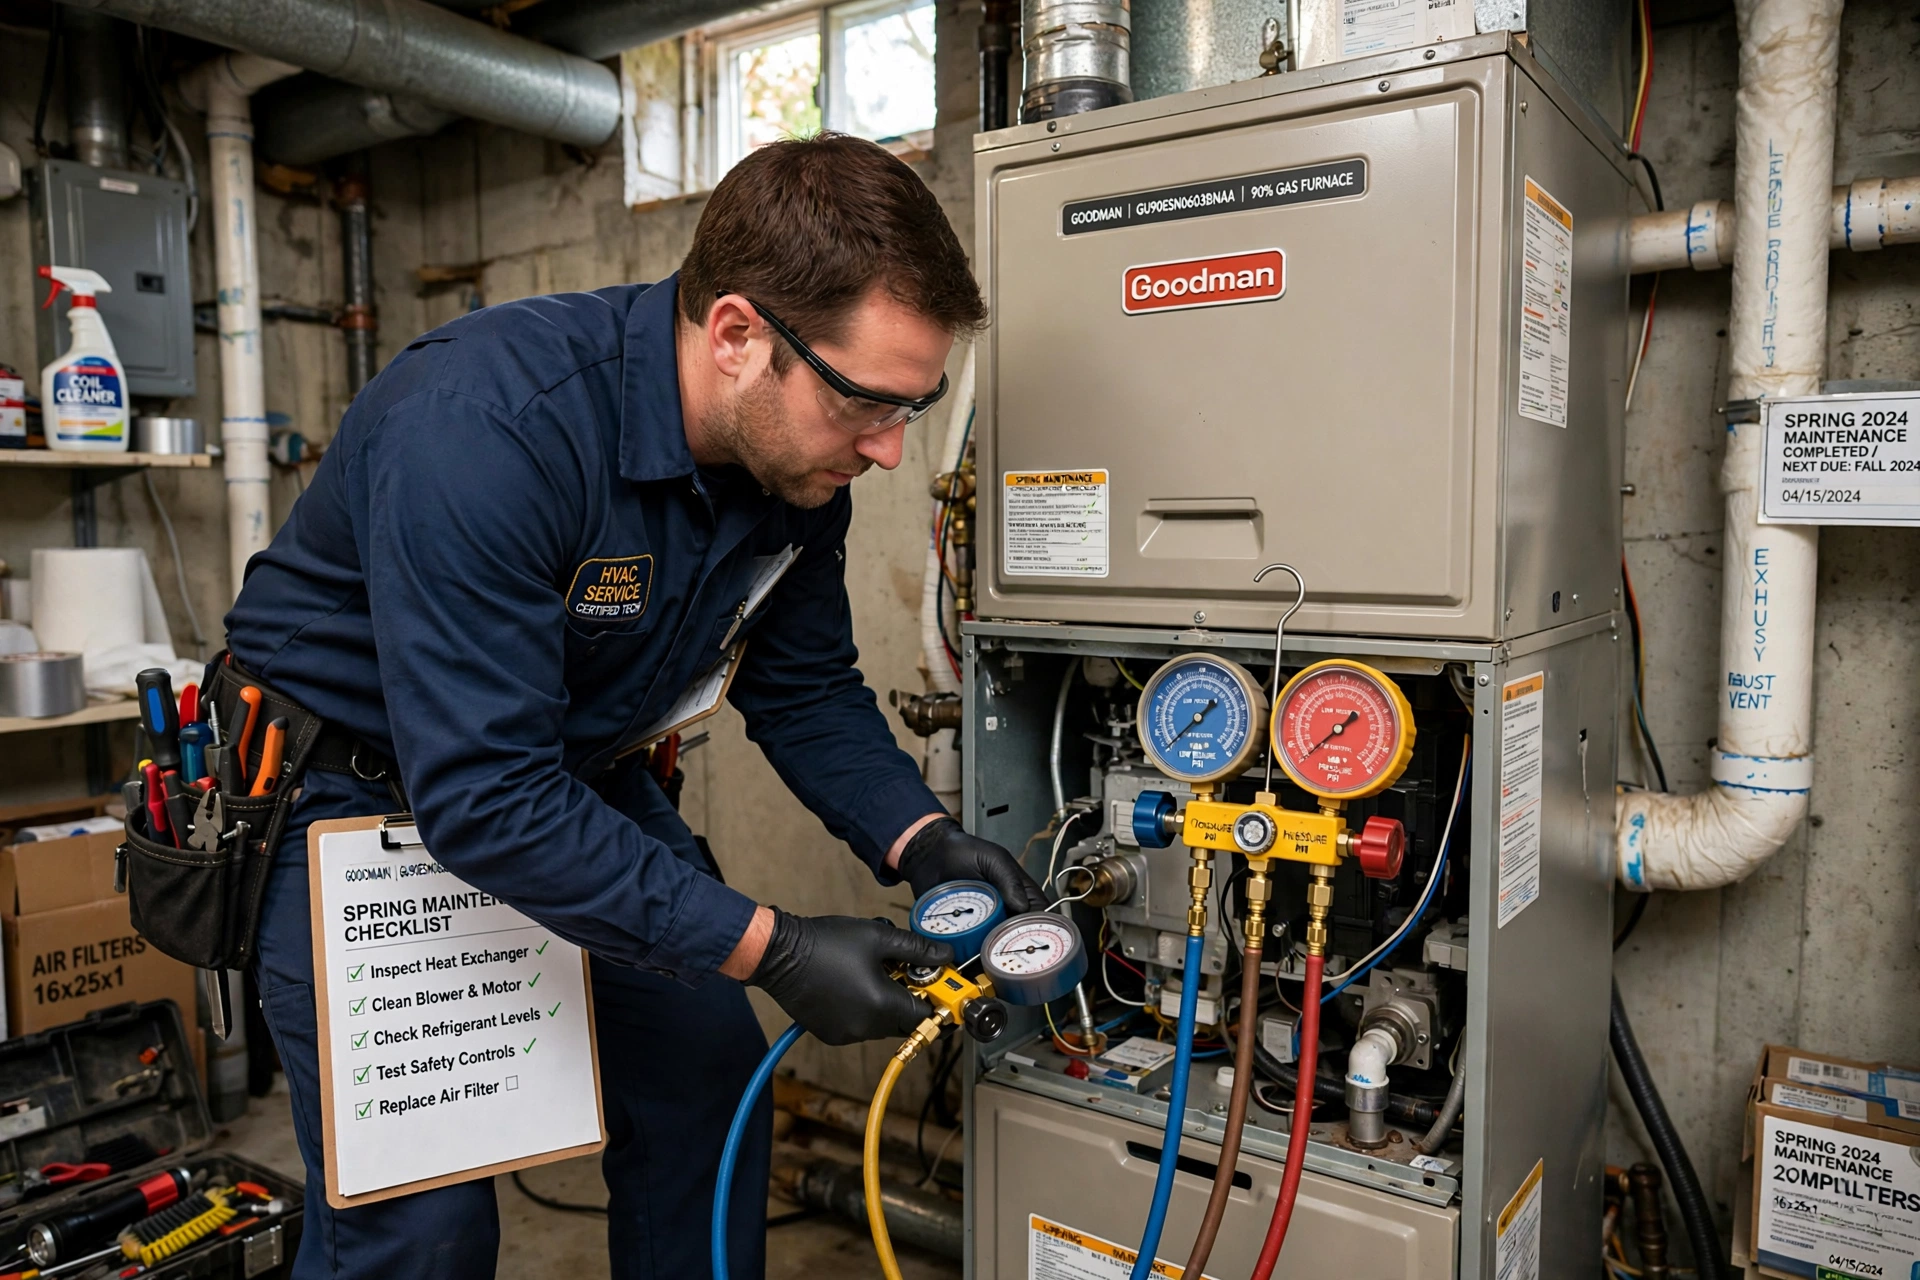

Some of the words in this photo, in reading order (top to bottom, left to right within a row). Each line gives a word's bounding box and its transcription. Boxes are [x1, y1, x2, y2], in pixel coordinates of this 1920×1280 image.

[1071, 206, 1122, 225] GOODMAN
[1251, 184, 1274, 199] 90%
[1276, 180, 1298, 195] GAS
[1301, 172, 1354, 192] FURNACE
[1131, 267, 1275, 301] Goodman
[56, 388, 116, 404] CLEANER
[69, 375, 103, 389] COIL
[1784, 412, 1855, 428] SPRING
[1861, 411, 1908, 427] 2024
[1784, 429, 1907, 444] MAINTENANCE
[1782, 461, 1818, 472] NEXT
[1820, 461, 1852, 472] DUE:
[1855, 460, 1886, 472] FALL
[1889, 460, 1920, 472] 2024
[1783, 446, 1869, 458] COMPLETED
[1782, 489, 1861, 503] 04/15/2024
[600, 565, 638, 583] HVAC
[584, 583, 641, 602] SERVICE
[1729, 691, 1772, 709] VENT
[343, 899, 417, 922] SPRING
[344, 915, 452, 943] CHECKLIST
[33, 950, 66, 977] AIR
[73, 934, 146, 968] FILTERS
[371, 960, 421, 979] Inspect
[425, 955, 458, 971] Heat
[461, 946, 529, 966] Exchanger
[34, 964, 124, 1005] 16x25x1
[372, 996, 412, 1012] Clean
[416, 988, 464, 1006] Blower
[468, 984, 478, 998] &
[482, 979, 522, 996] Motor
[374, 1026, 419, 1046] Check
[422, 1015, 497, 1038] Refrigerant
[501, 1007, 541, 1025] Levels
[376, 1062, 407, 1080] Test
[411, 1055, 455, 1074] Safety
[458, 1045, 515, 1065] Controls
[379, 1094, 436, 1116] Replace
[440, 1087, 460, 1104] Air
[464, 1082, 500, 1099] Filter
[1775, 1130, 1836, 1154] SPRING
[1841, 1145, 1882, 1165] 2024
[1774, 1145, 1893, 1183] MAINTENANCE
